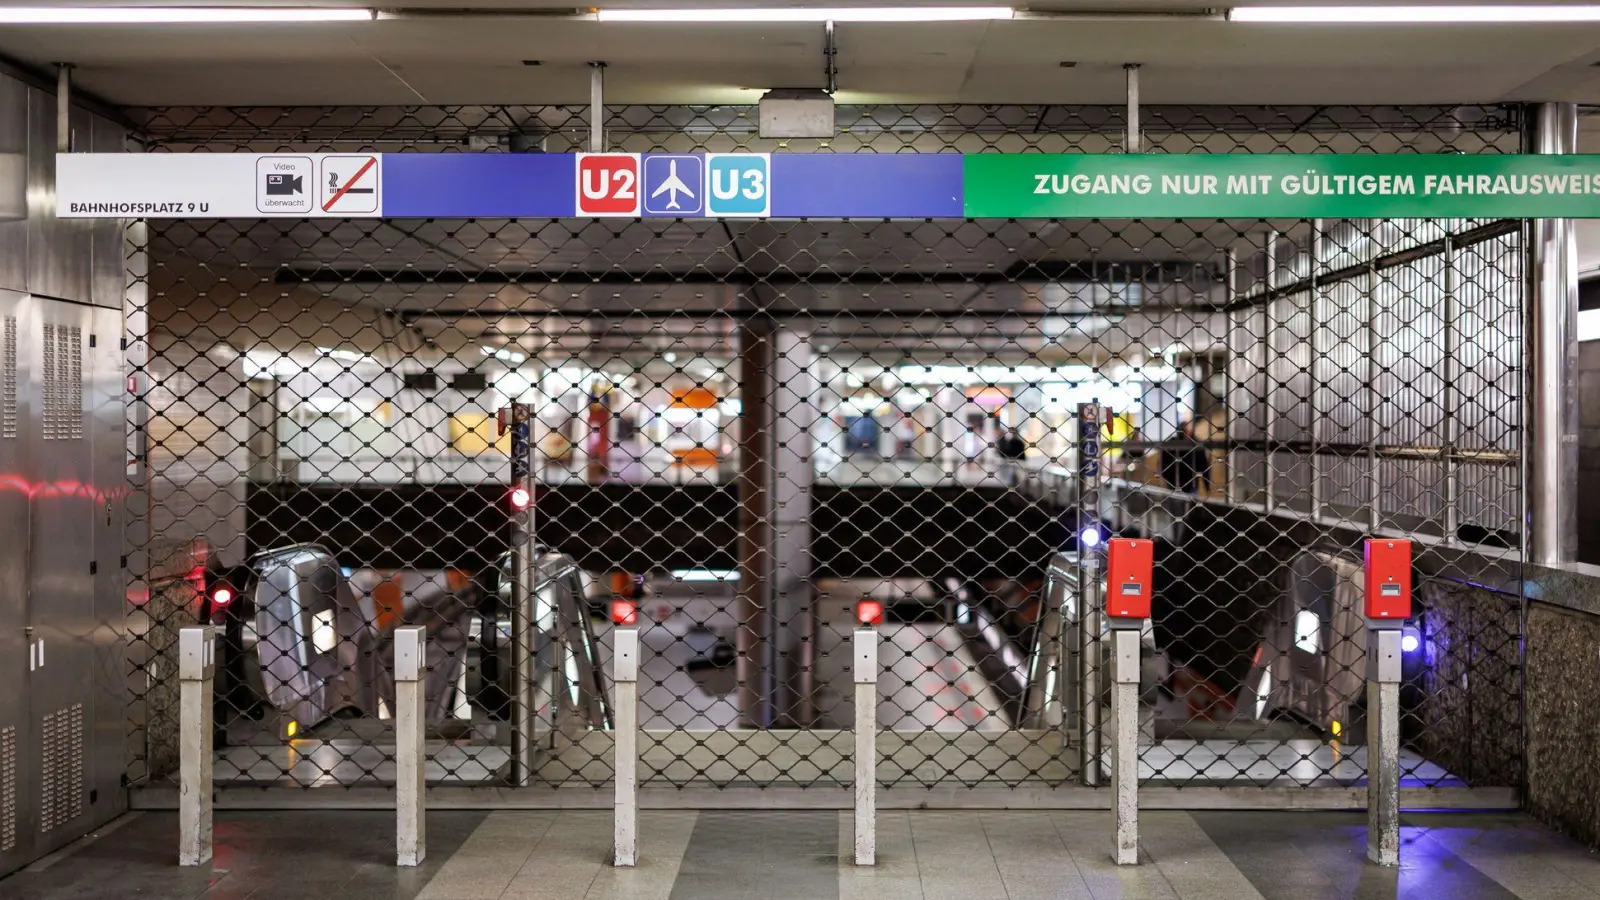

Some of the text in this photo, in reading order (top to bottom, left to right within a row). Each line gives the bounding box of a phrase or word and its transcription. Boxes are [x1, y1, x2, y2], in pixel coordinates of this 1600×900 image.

[273, 162, 296, 171] Video
[582, 169, 635, 199] U2
[712, 169, 764, 199] U3
[1033, 172, 1154, 196] ZUGANG
[1160, 173, 1221, 196] NUR
[1226, 173, 1272, 195] MIT
[1280, 168, 1416, 196] GÜLTIGEM
[70, 202, 209, 213] BAHNHOFSPLATZ 9 U
[264, 197, 304, 207] überwacht
